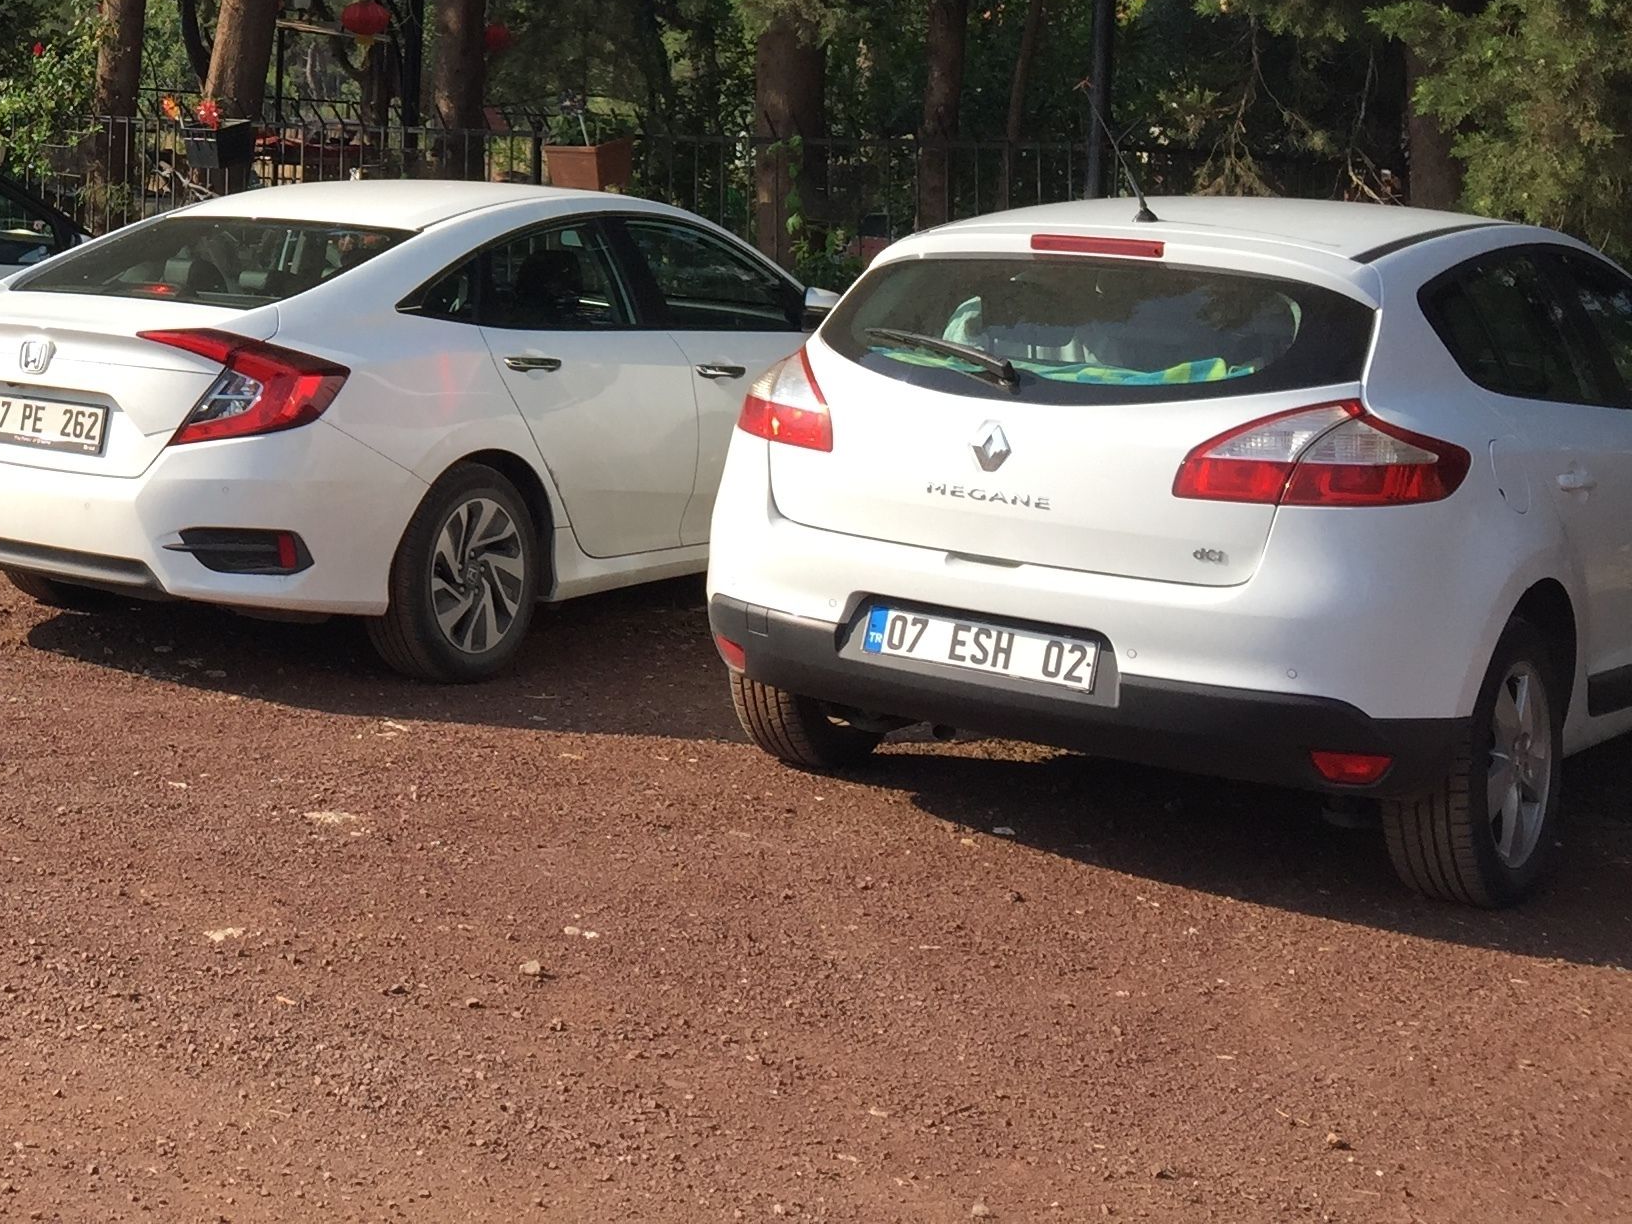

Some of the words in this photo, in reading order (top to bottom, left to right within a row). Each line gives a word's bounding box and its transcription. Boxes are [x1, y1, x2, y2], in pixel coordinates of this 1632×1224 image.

[20, 403, 46, 433] PE
[60, 408, 100, 441] 262
[926, 481, 1052, 511] MEGANE
[869, 630, 884, 644] TR
[887, 615, 930, 653] 07
[948, 623, 1016, 670] ESH
[1041, 639, 1089, 684] 02
